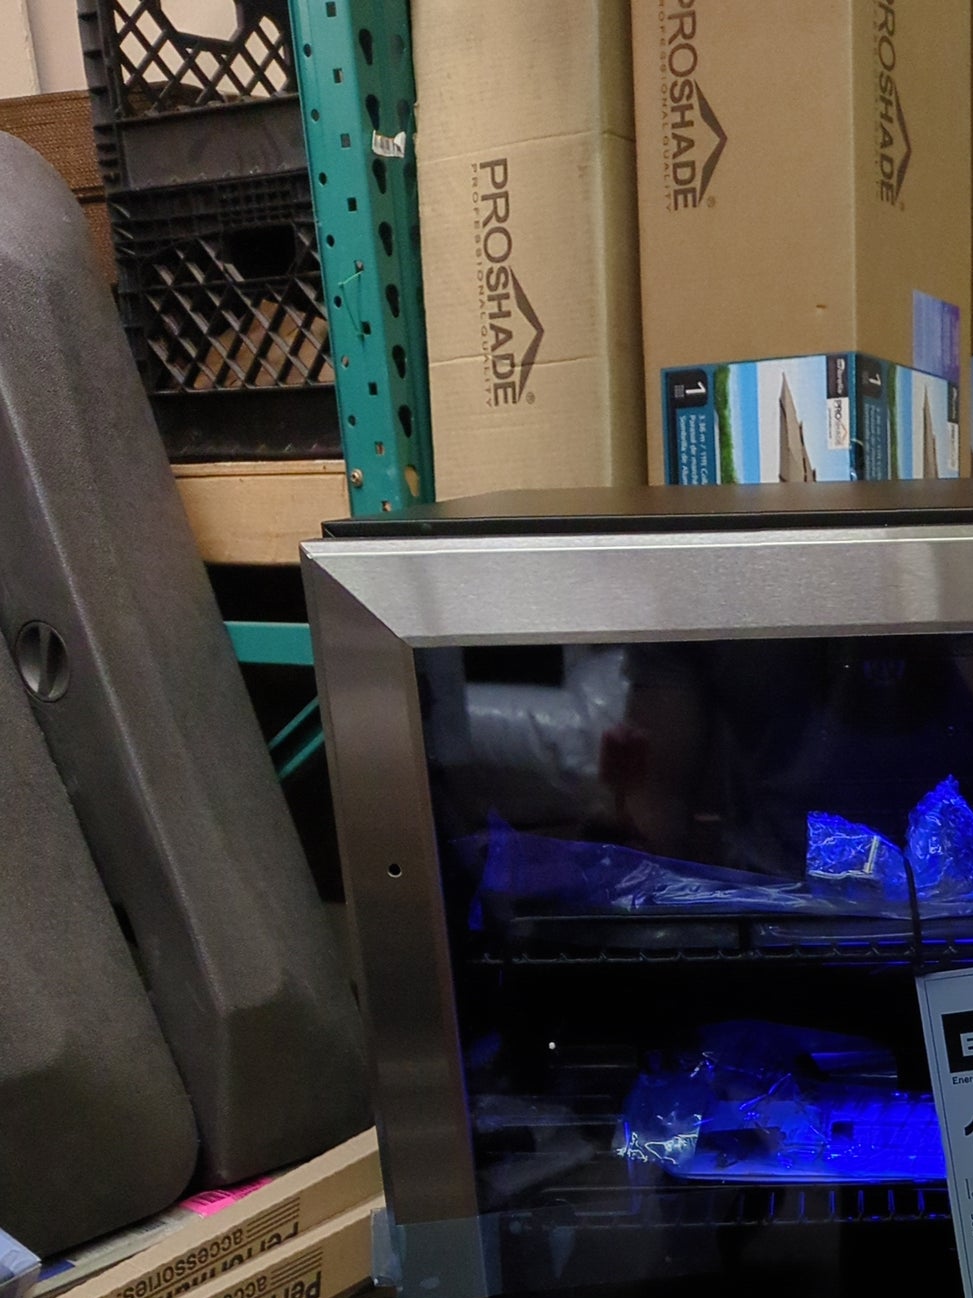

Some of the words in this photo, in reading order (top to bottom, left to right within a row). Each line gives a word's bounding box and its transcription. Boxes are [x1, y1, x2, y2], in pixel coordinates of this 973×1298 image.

[657, 0, 668, 130] ROFESSIONAL
[667, 0, 698, 210] ROSHADE
[878, 0, 896, 206] ROSHADE
[662, 134, 673, 213] QUALITY
[471, 162, 487, 320] PROFESSIONAL
[480, 324, 493, 408] QUALITY
[479, 157, 517, 407] PROSHADE
[685, 381, 707, 395] 1
[868, 373, 882, 387] 1
